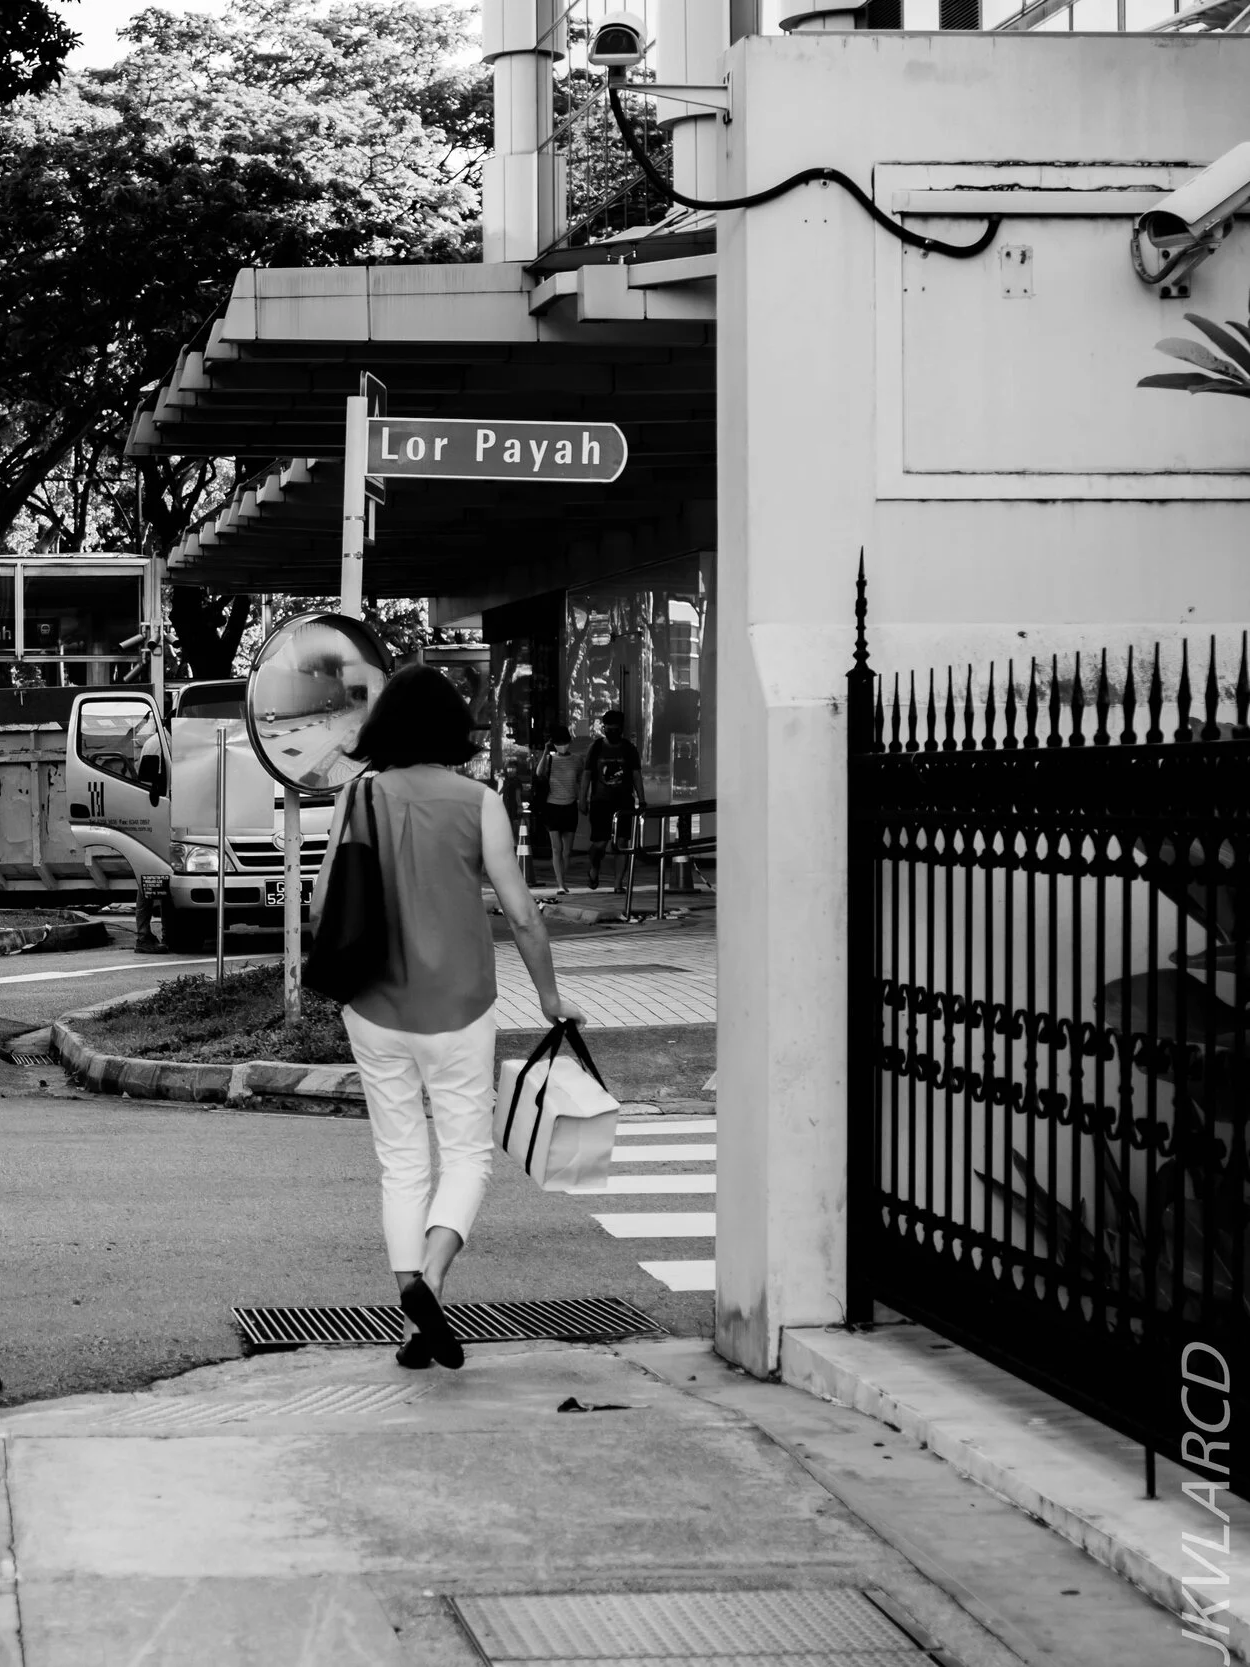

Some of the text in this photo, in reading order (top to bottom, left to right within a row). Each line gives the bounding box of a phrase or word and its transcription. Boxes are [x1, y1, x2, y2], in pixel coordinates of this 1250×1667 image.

[381, 426, 600, 472] Lor Payah
[267, 892, 312, 905] 52J
